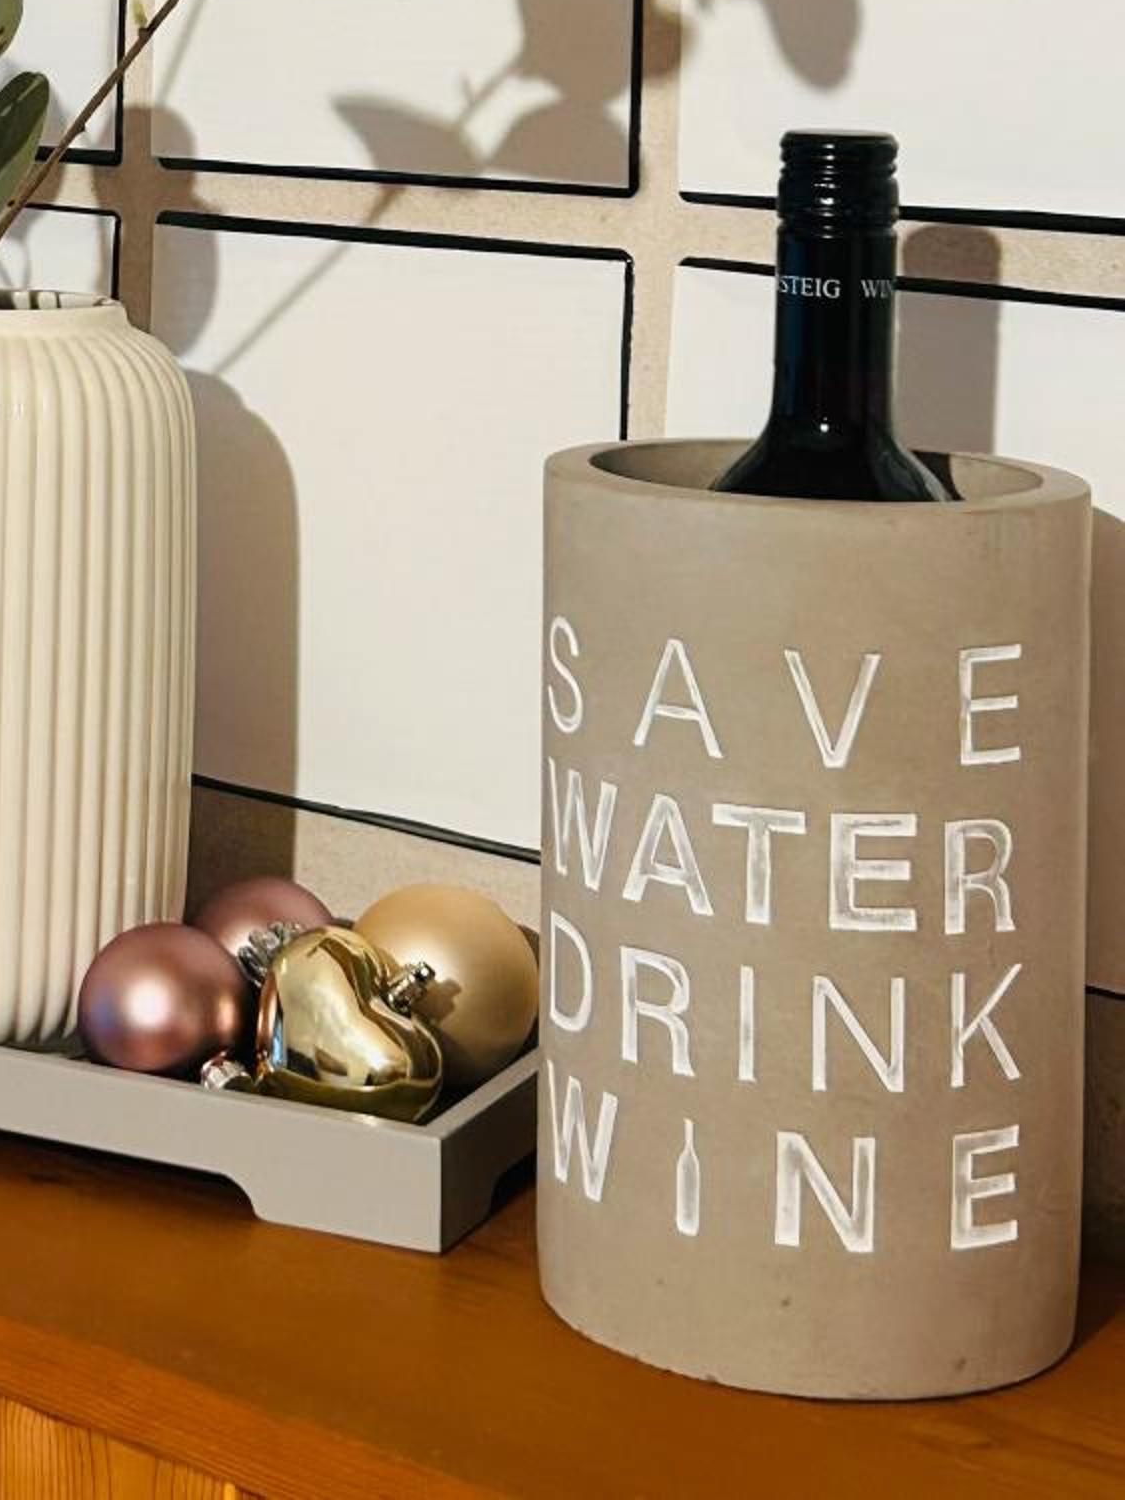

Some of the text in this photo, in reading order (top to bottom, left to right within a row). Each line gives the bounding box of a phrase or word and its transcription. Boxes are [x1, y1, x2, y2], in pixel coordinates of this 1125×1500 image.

[548, 615, 1023, 769] SAVE
[548, 756, 1017, 935] WATER
[549, 909, 1023, 1094] DRINK
[547, 1059, 1020, 1253] WINE
